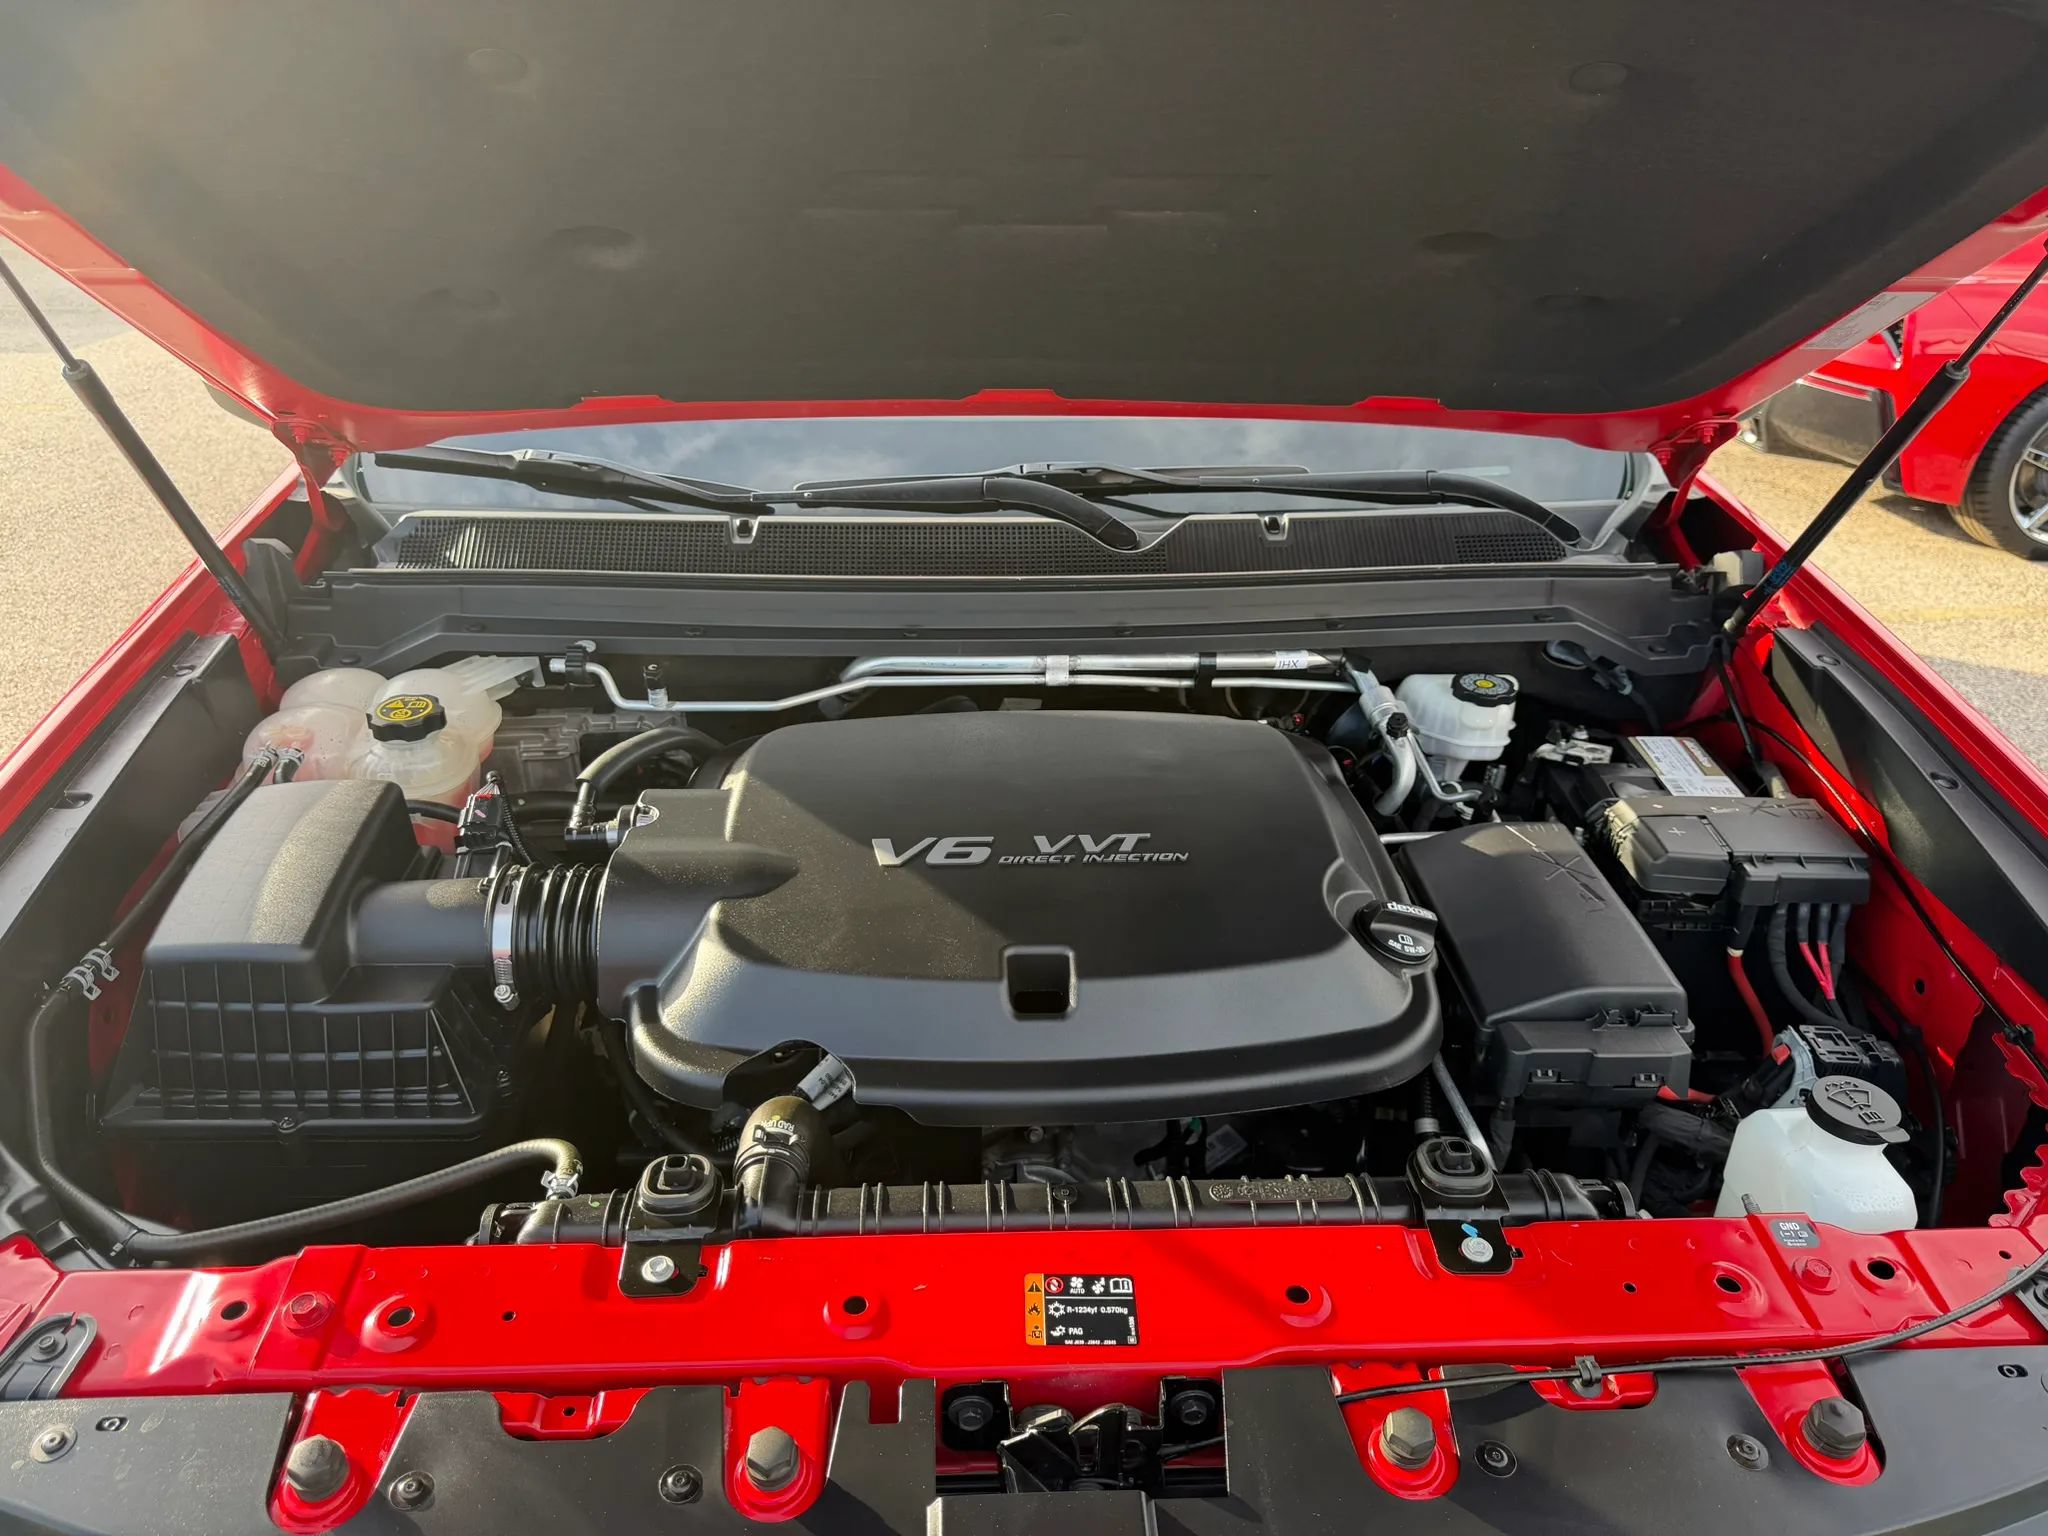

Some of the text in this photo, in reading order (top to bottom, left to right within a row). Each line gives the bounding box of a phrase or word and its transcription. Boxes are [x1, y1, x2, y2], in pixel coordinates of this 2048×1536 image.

[1033, 832, 1151, 853] VVT
[871, 836, 995, 867] V6
[998, 851, 1189, 865] DIRECT INJECTION
[777, 1120, 795, 1132] RAD
[1779, 1222, 1800, 1230] GND
[1066, 1306, 1129, 1315] R-1234yf 0.570kg
[1068, 1327, 1083, 1335] PAG
